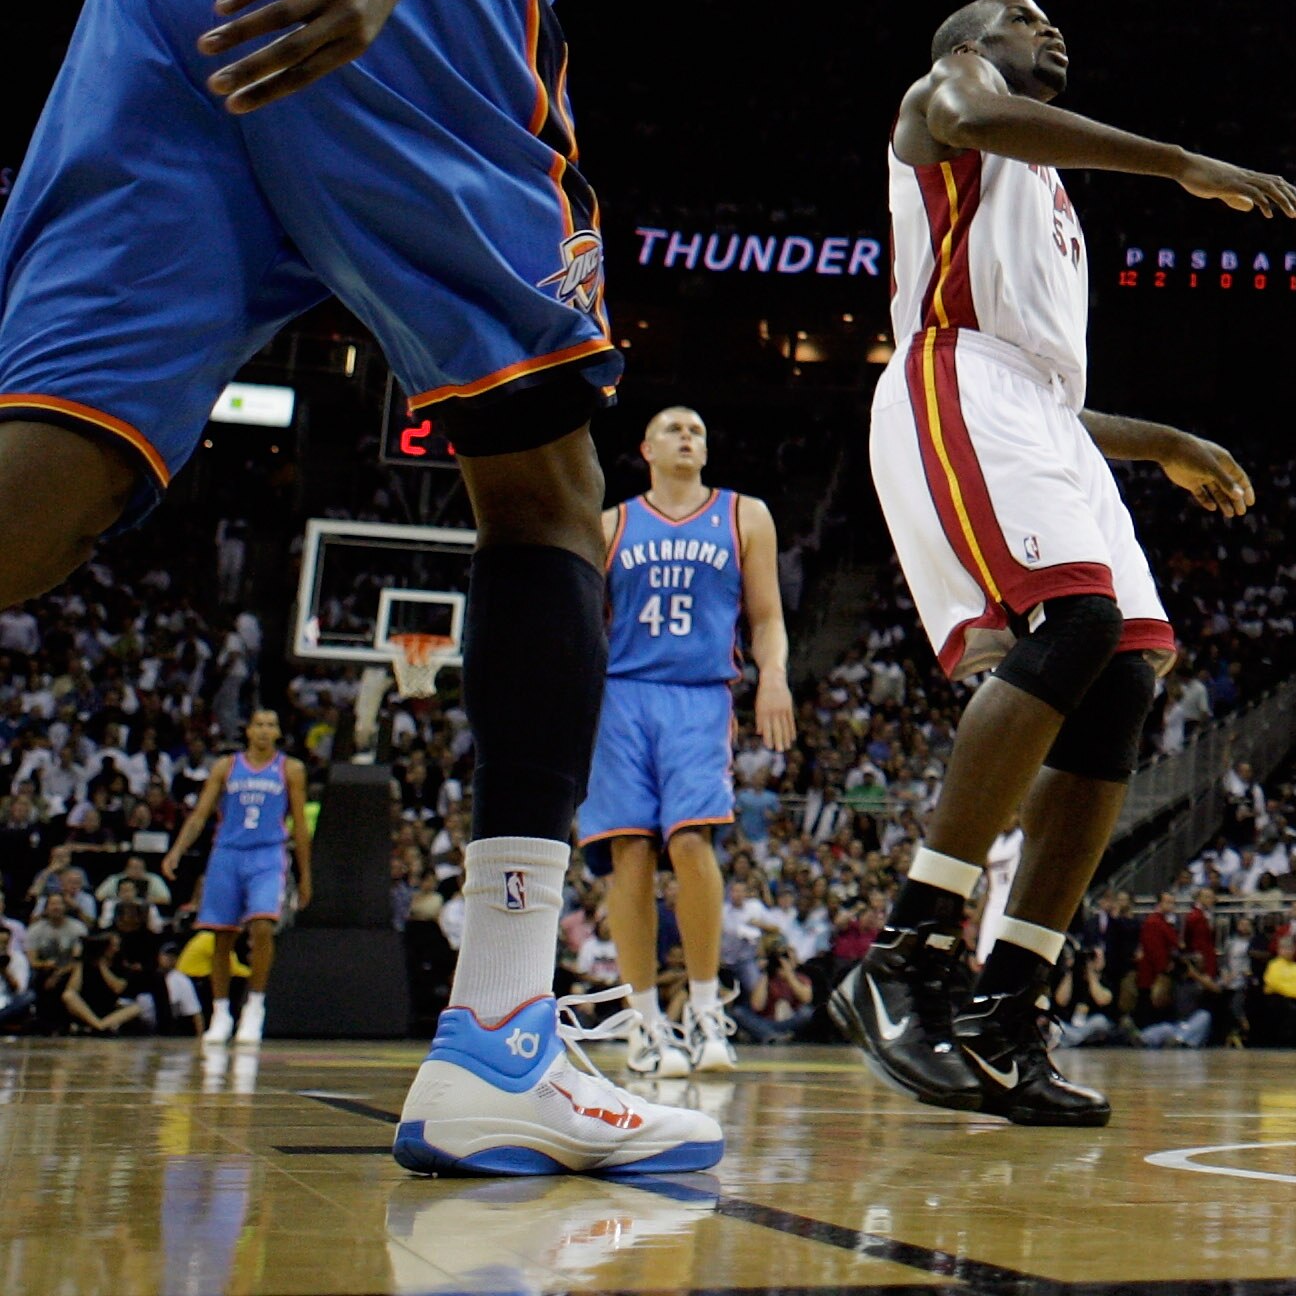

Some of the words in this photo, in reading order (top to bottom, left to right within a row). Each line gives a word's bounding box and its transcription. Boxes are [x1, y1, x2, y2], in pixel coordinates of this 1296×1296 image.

[634, 225, 882, 277] THUNDER
[1125, 247, 1144, 268] P
[1156, 247, 1176, 269] R
[1190, 248, 1208, 269] S
[1220, 249, 1238, 271] B
[1252, 251, 1270, 272] A
[1118, 270, 1139, 287] 12
[1154, 271, 1168, 288] 2
[1188, 271, 1198, 288] 1
[1220, 272, 1233, 289] 0
[1254, 273, 1268, 290] 0
[620, 538, 729, 570] OKLAHOMA
[649, 565, 695, 589] CITY
[638, 594, 693, 637] 45
[244, 805, 261, 830] 2
